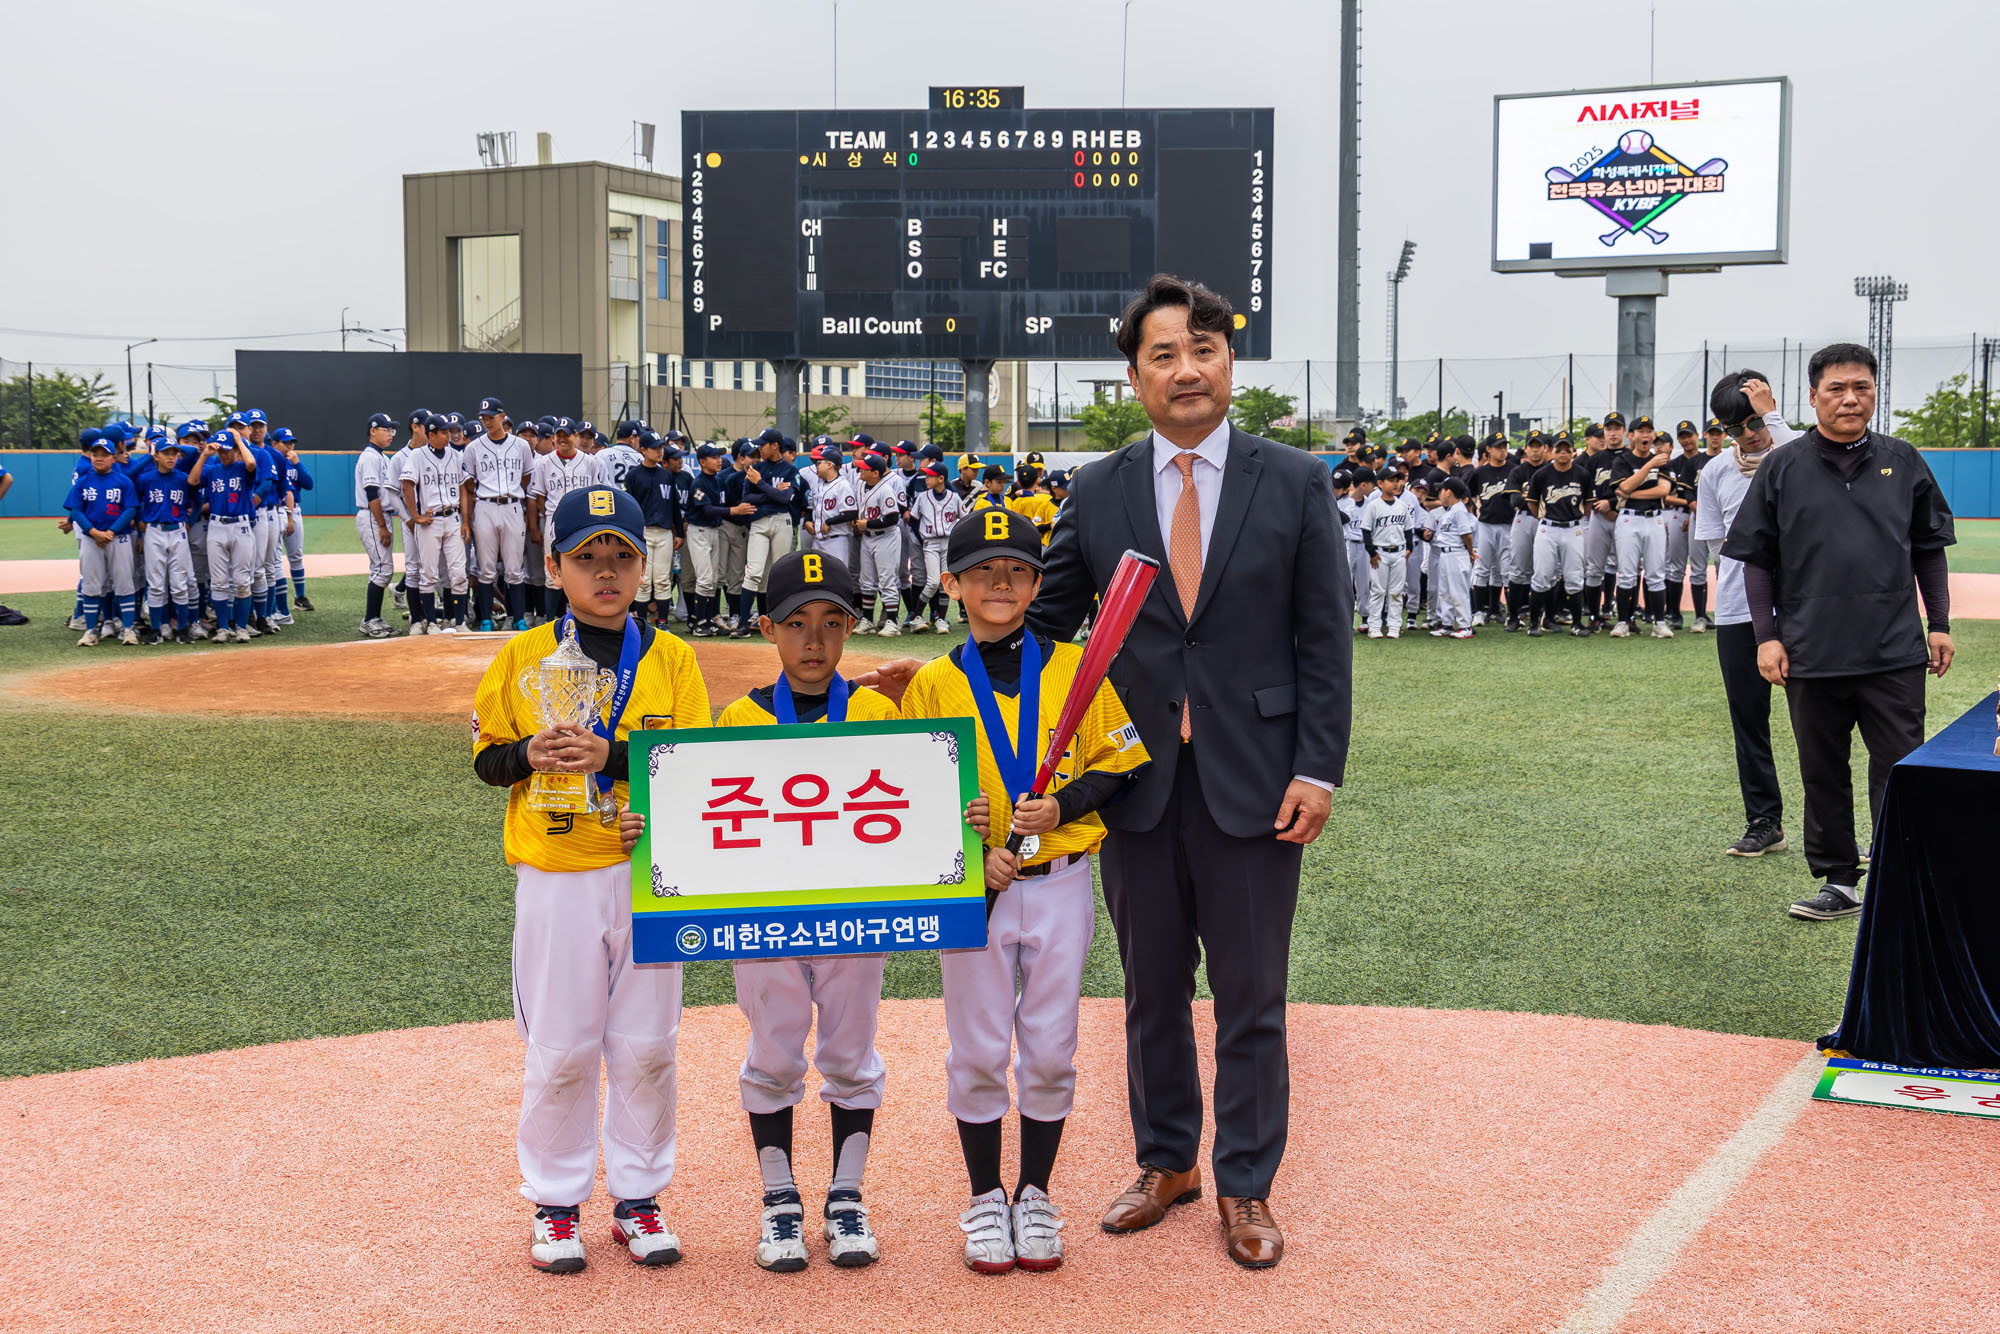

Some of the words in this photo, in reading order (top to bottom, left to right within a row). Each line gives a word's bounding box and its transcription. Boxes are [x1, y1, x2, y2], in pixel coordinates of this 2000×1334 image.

[943, 89, 1001, 108] 16:35
[1577, 99, 1699, 122] 시사저널
[826, 130, 886, 149] TEAM
[909, 152, 918, 166] 0
[1569, 145, 1604, 173] 2025
[1549, 175, 1723, 200] 전국유소년야구대회
[1612, 196, 1661, 211] KYBF
[802, 219, 821, 236] CH
[908, 219, 922, 236] B
[993, 219, 1007, 236] H
[908, 240, 922, 257] S
[993, 240, 1007, 257] E
[908, 261, 922, 278] O
[980, 261, 1008, 278] FC
[710, 315, 722, 331] P
[823, 317, 861, 334] Ball
[865, 317, 922, 335] Count
[946, 318, 956, 333] 0
[1025, 316, 1053, 334] SP
[482, 401, 489, 409] D
[481, 459, 521, 472] DAECHI
[424, 473, 459, 486] DAECH
[510, 472, 514, 482] 1
[549, 476, 589, 491] DAECHI
[229, 493, 239, 503] 31
[450, 487, 457, 496] 6
[660, 484, 671, 499] W
[678, 490, 689, 504] W
[106, 504, 120, 516] 22
[824, 498, 837, 510] W
[867, 506, 881, 519] W
[984, 511, 1010, 540] B
[118, 535, 128, 543] 22
[803, 554, 823, 583] B
[701, 769, 910, 850] 준우승
[713, 914, 940, 952] 대한유소년야구연맹
